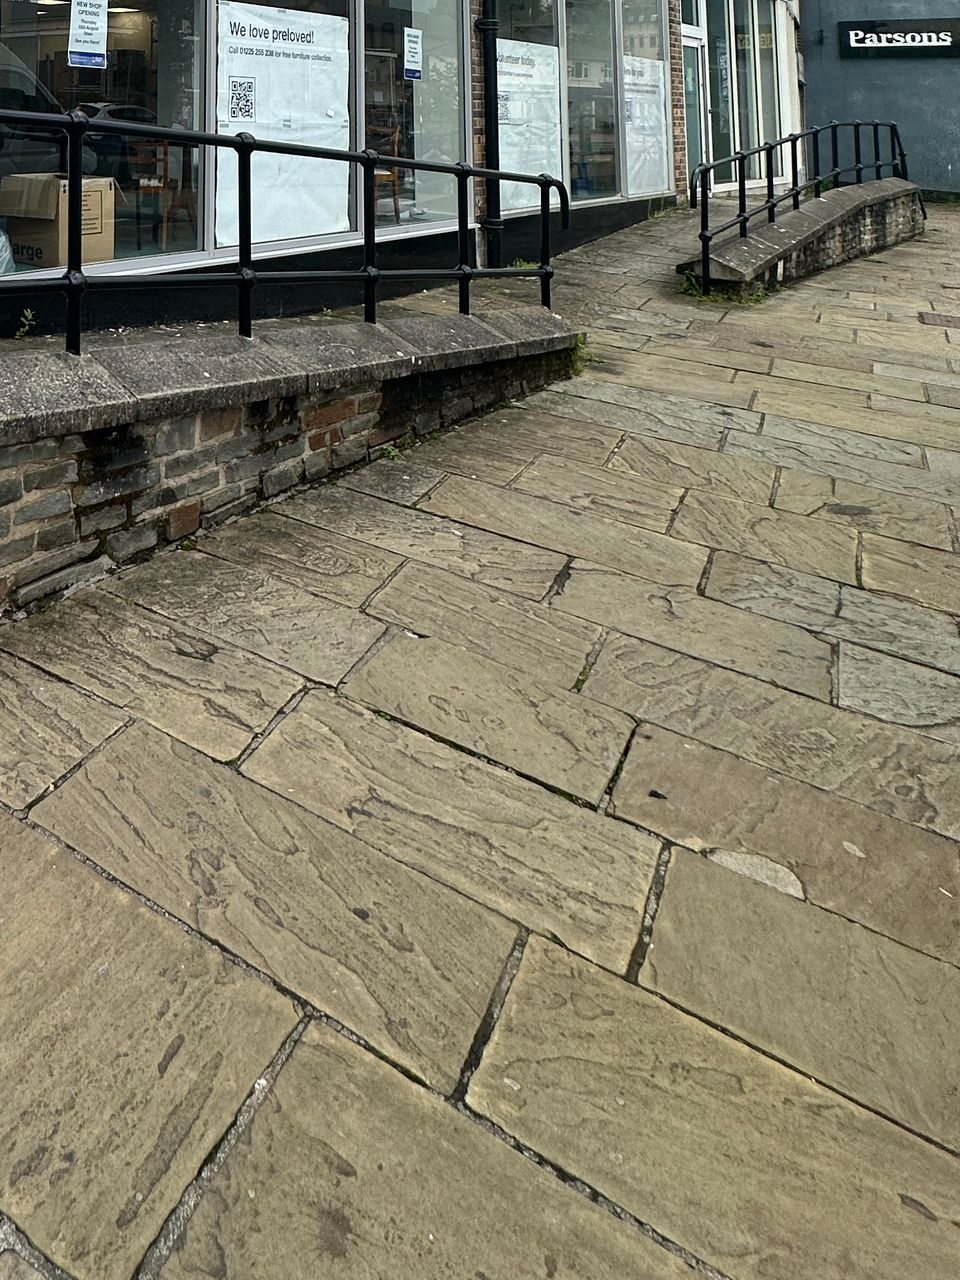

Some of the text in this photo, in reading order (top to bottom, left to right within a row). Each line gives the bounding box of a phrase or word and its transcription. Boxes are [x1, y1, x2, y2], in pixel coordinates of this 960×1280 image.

[78, 9, 100, 17] OPENING
[229, 21, 314, 44] We love preloved!
[848, 30, 953, 47] Parsons
[228, 45, 239, 54] Call
[239, 47, 254, 56] 01225
[282, 50, 291, 59] free
[292, 51, 310, 60] furniture
[12, 243, 44, 260] arge
